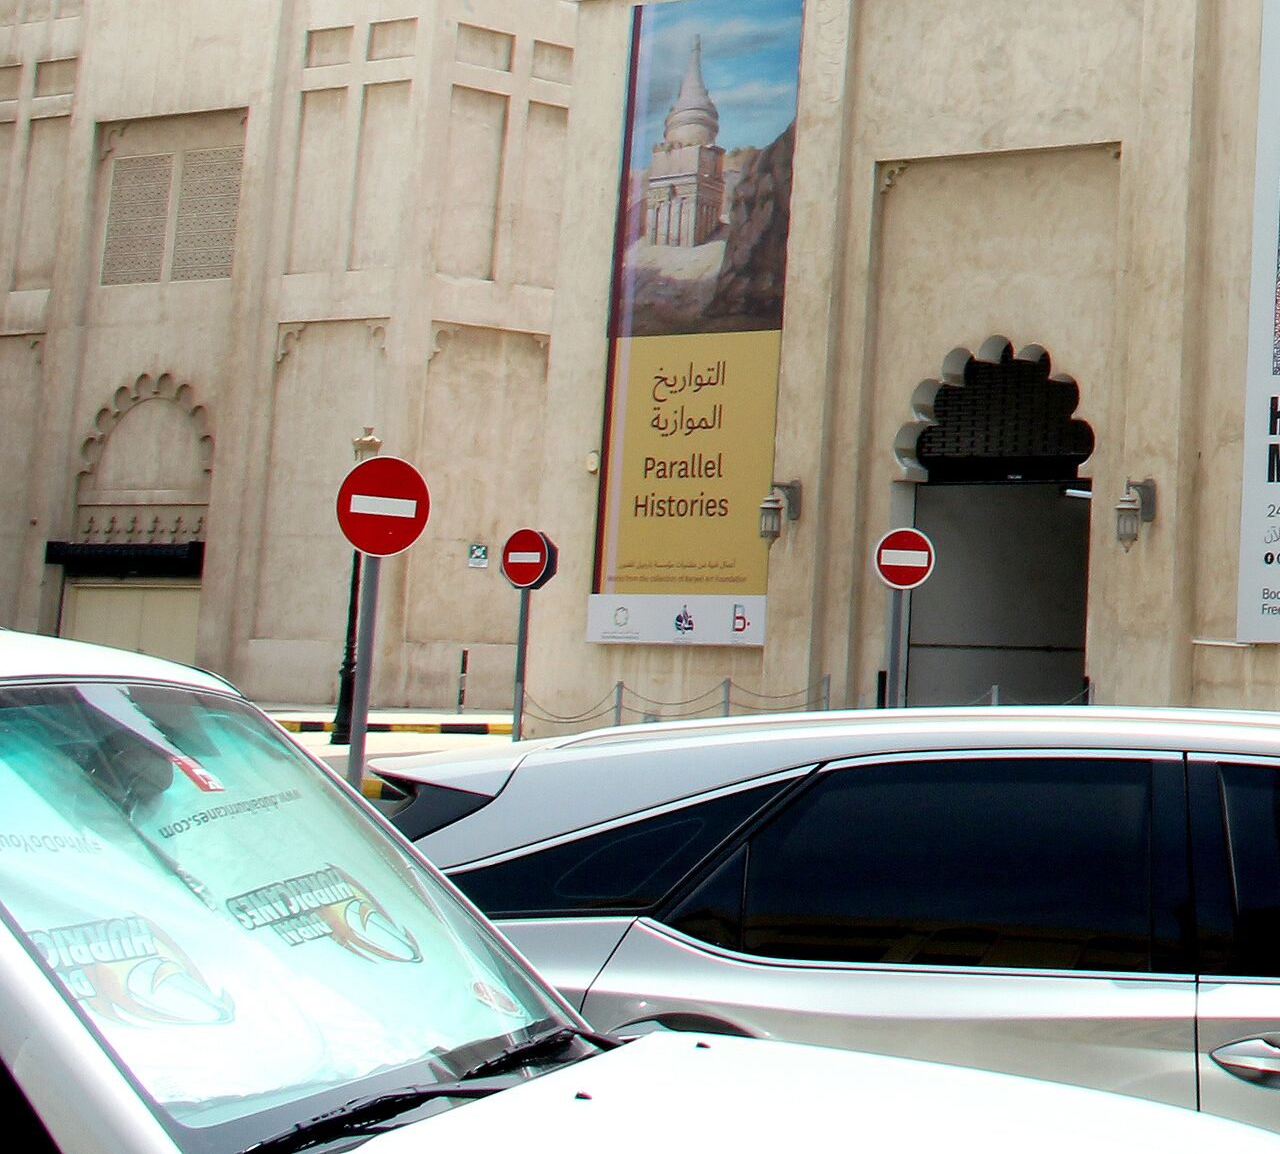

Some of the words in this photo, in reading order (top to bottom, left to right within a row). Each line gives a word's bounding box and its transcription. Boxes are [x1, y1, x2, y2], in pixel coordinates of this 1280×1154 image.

[652, 360, 727, 402] التواريخ
[651, 404, 723, 437] الموازية
[643, 452, 724, 479] Parallel
[633, 491, 730, 518] Histories
